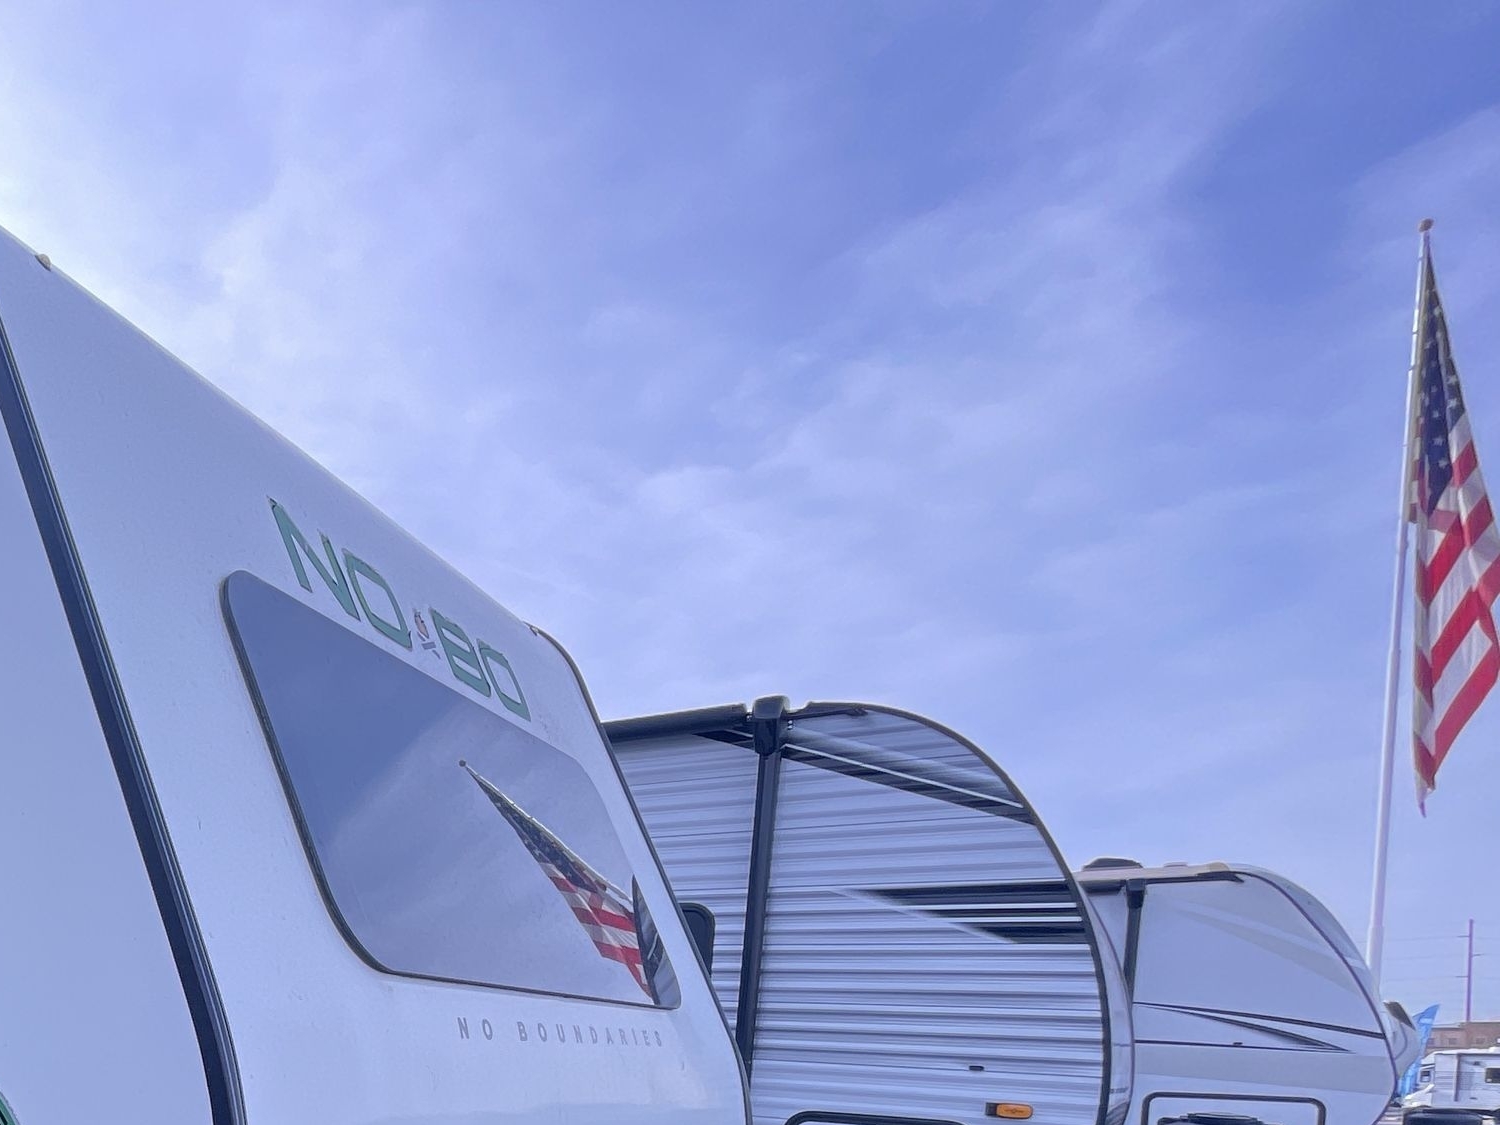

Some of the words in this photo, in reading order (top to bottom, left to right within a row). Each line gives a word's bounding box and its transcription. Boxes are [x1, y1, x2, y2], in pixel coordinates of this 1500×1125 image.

[266, 495, 412, 650] NO
[430, 606, 531, 721] BO
[457, 1017, 493, 1040] NO
[516, 1021, 662, 1047] BOUNDARIES
